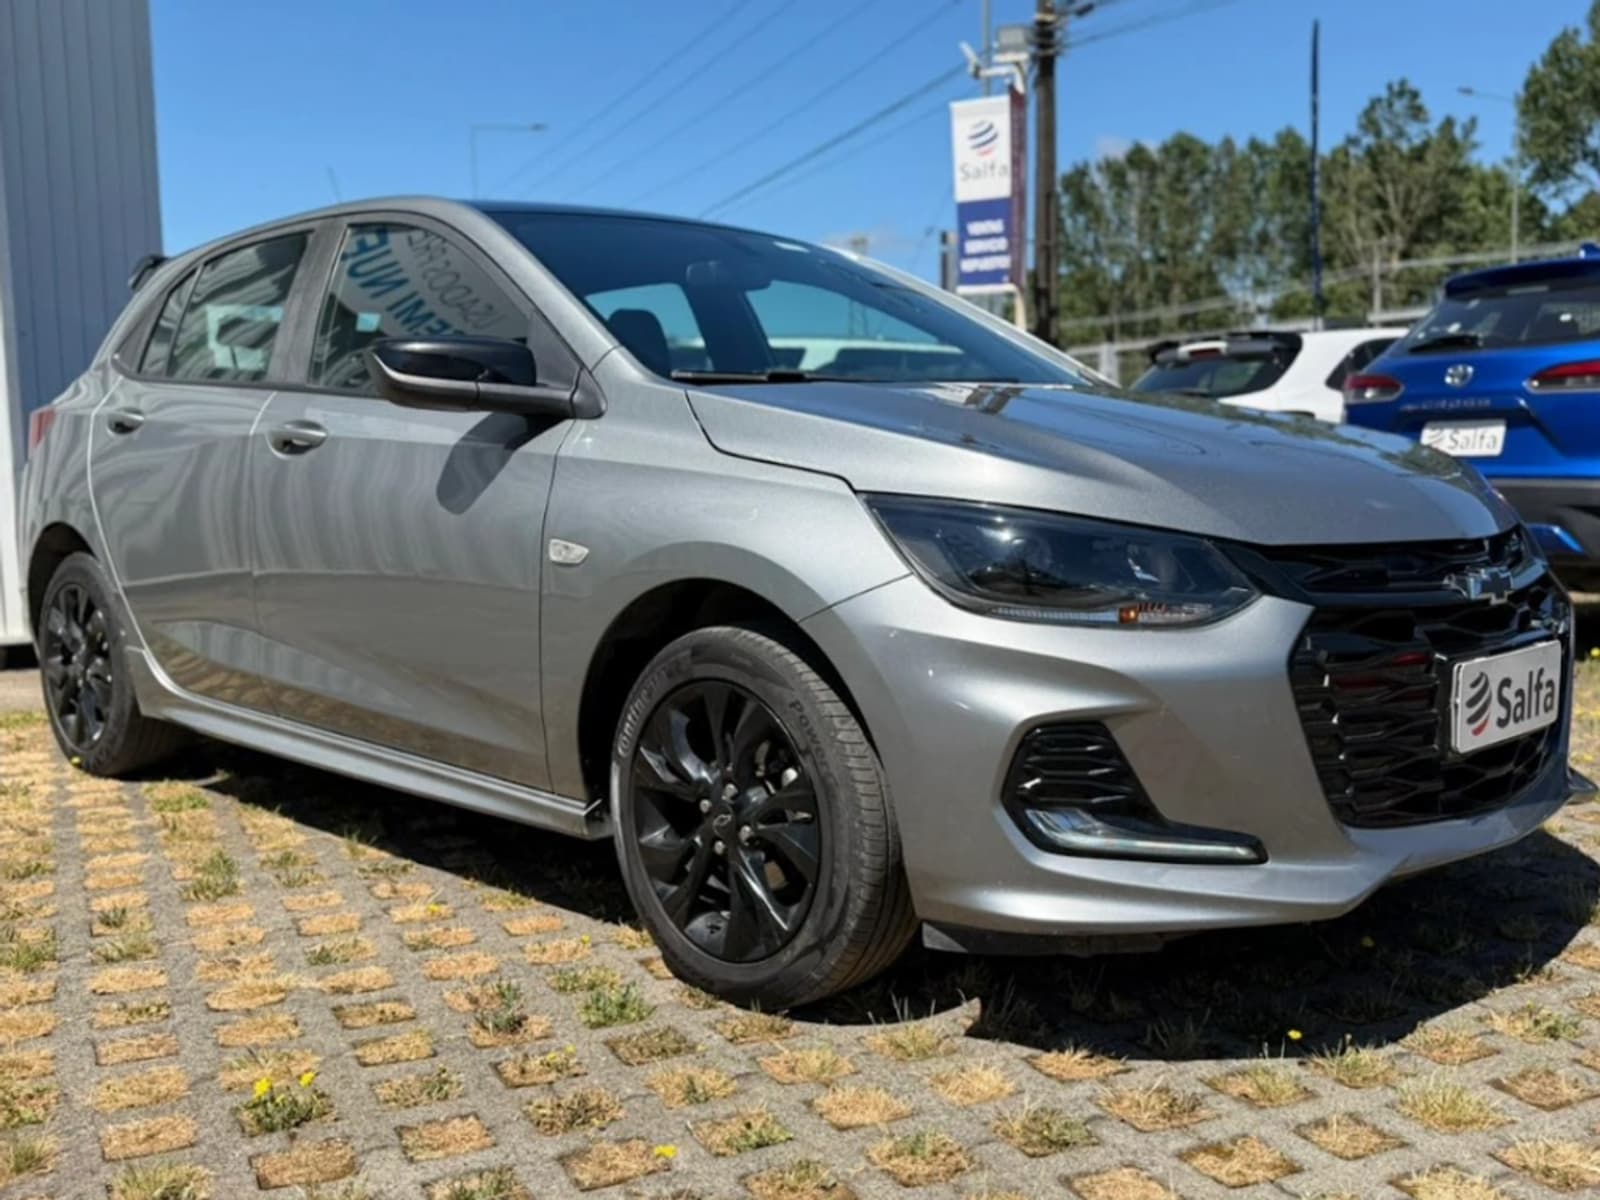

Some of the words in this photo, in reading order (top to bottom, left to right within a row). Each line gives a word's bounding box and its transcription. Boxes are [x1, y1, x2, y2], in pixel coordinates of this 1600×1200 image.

[960, 160, 1009, 181] Salfa
[1448, 428, 1497, 450] Salfa
[1496, 667, 1556, 729] Salfa
